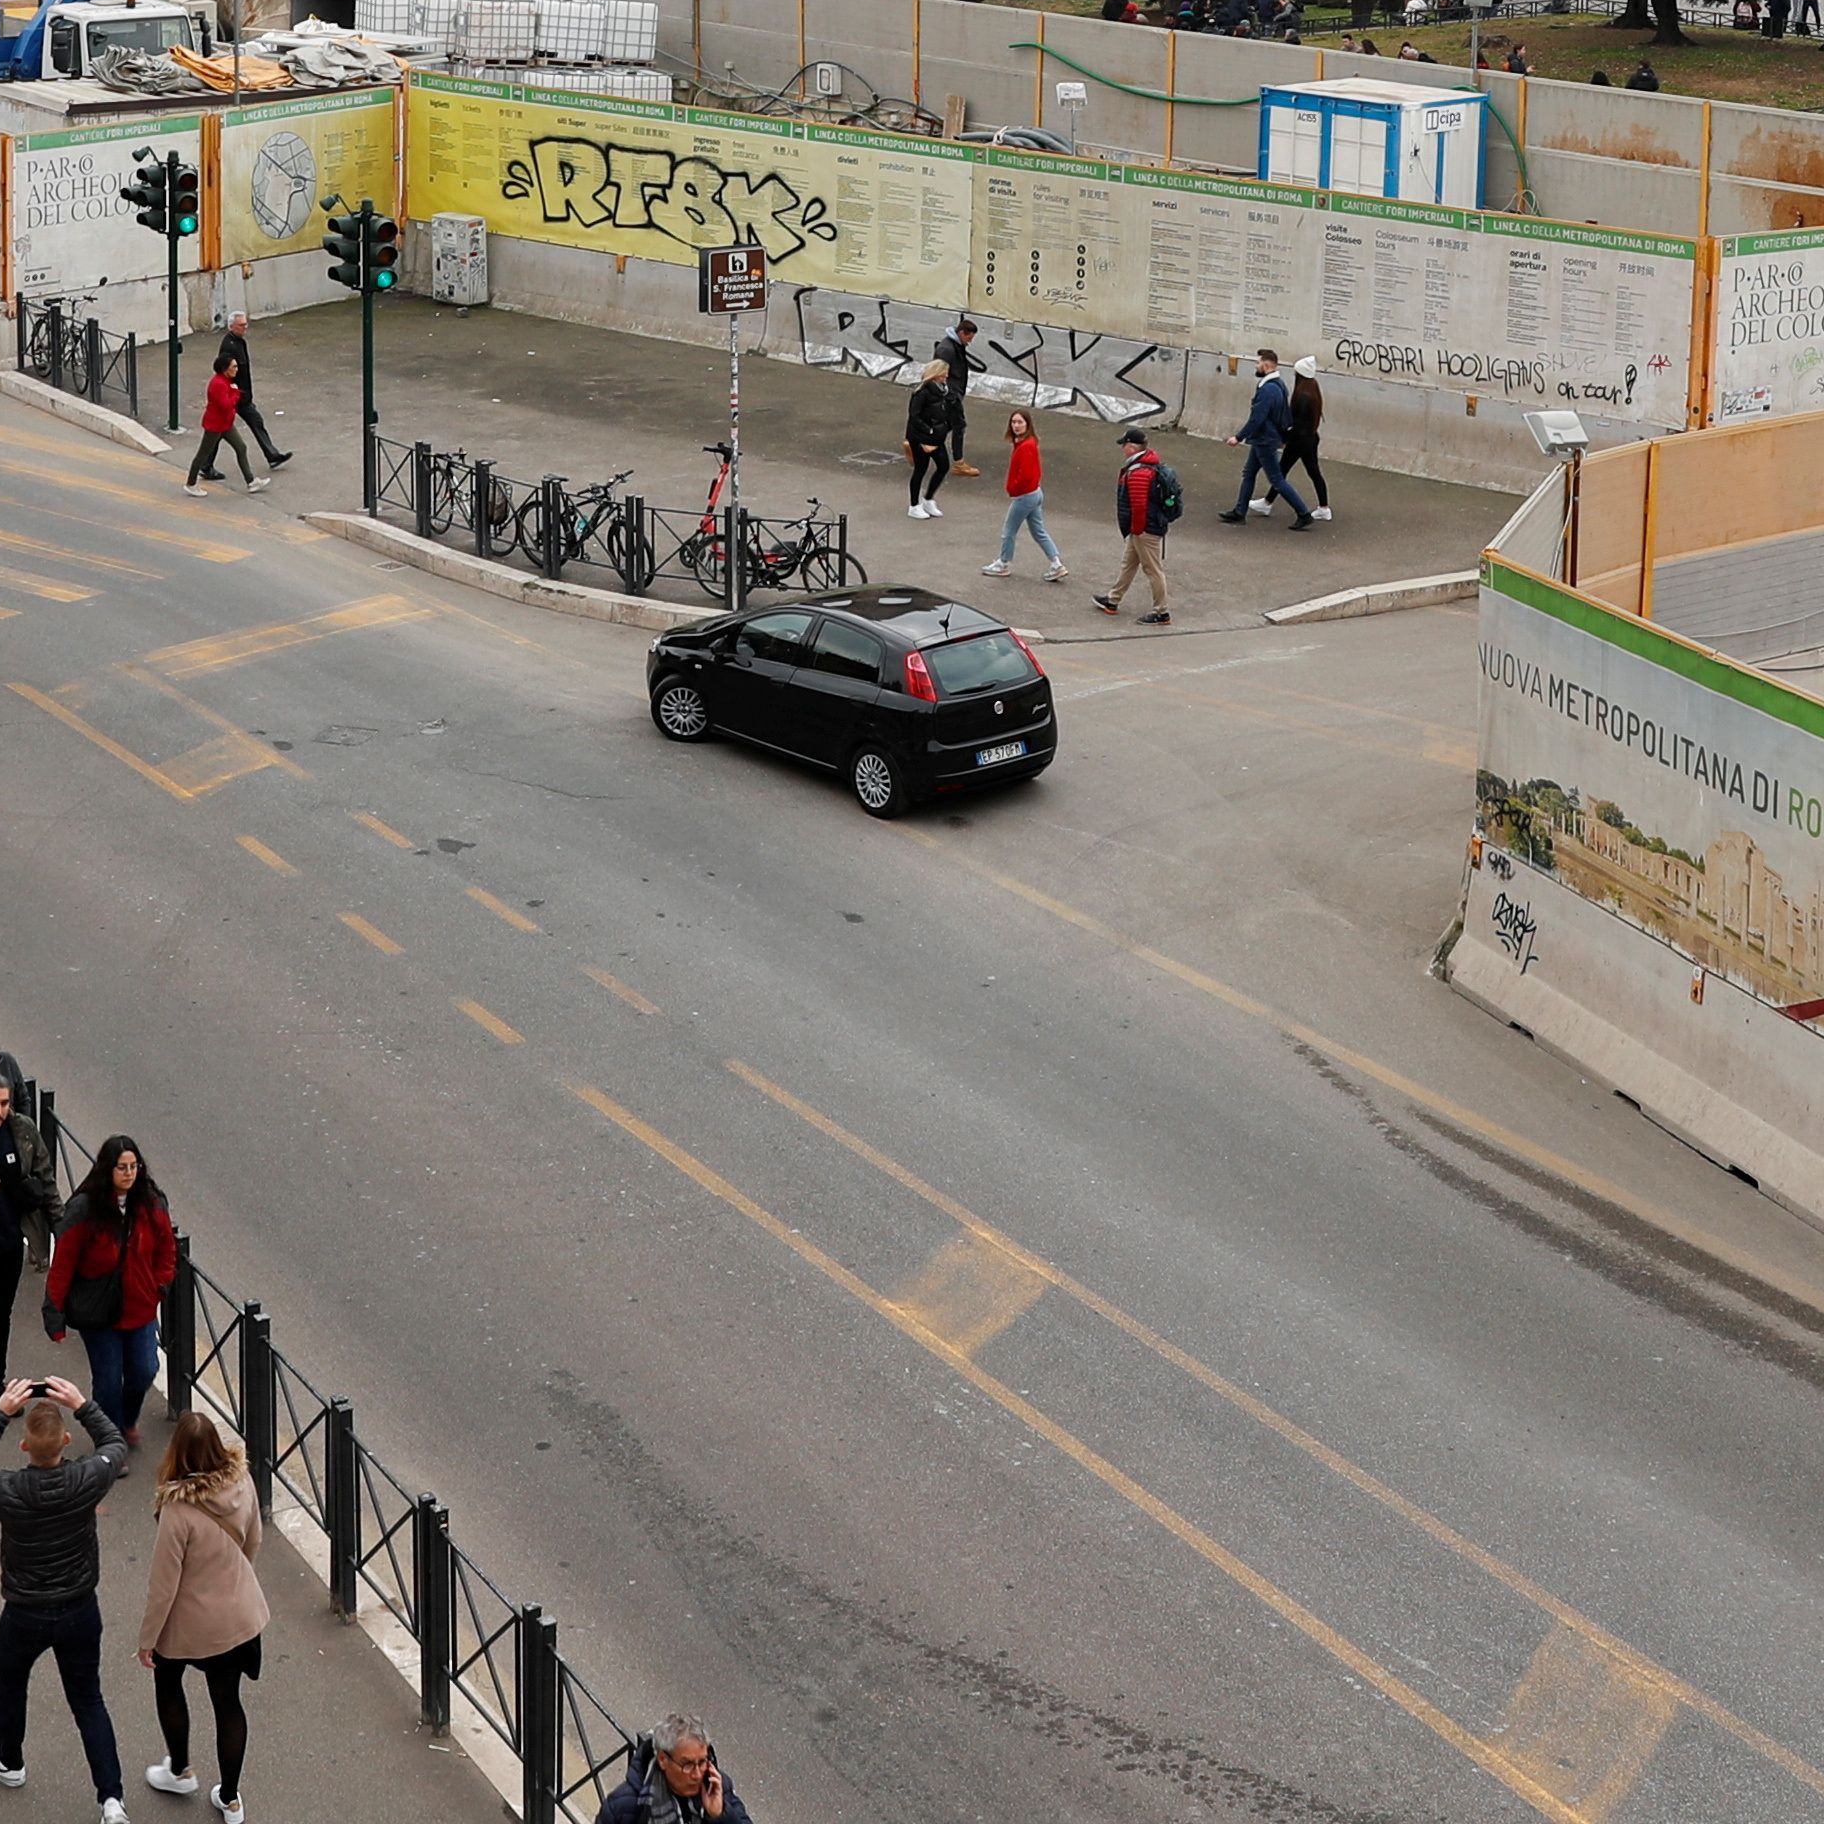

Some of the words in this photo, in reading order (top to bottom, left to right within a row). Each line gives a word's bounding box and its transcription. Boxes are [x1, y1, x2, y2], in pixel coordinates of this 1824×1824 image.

[695, 112, 727, 126] CANTIERE
[728, 117, 746, 129] FORI
[747, 120, 783, 134] IMPERIALI
[1439, 111, 1461, 125] cipa
[815, 128, 836, 140] LINEA
[838, 132, 844, 142] C
[845, 133, 867, 144] DELLA
[868, 136, 930, 154] METROPOLITANA
[931, 144, 939, 154] DI
[940, 146, 964, 158] ROMA
[837, 155, 858, 167] divieti
[878, 161, 915, 174] prohibition
[997, 154, 1035, 169] CANTIERE
[1036, 158, 1055, 171] FORI
[1056, 161, 1097, 177] IMPERIALI
[989, 177, 1013, 187] norme
[1033, 183, 1050, 193] rules
[1133, 172, 1156, 185] LINEA
[1158, 175, 1166, 186] C
[1167, 176, 1194, 189] DELLA
[1194, 180, 1265, 198] METROPOLITANA
[1266, 188, 1276, 200] DI
[1277, 190, 1303, 204] ROMA
[988, 186, 995, 195] di
[996, 186, 1017, 197] visita
[1032, 192, 1044, 201] for
[1045, 193, 1070, 207] visiting
[1152, 199, 1178, 210] servizi
[27, 205, 66, 229] DEL
[1199, 205, 1230, 218] services
[1341, 199, 1384, 215] CANTIERE
[1385, 204, 1407, 219] FORI
[1408, 207, 1454, 225] IMPERIALI
[1325, 223, 1348, 234] visite
[1325, 232, 1363, 246] Colosseo
[1376, 229, 1420, 245] Colosseum
[1493, 220, 1521, 233] LINEA
[1523, 223, 1531, 235] C
[1532, 225, 1561, 239] DELLA
[1562, 228, 1642, 248] METROPOLITANA
[1644, 238, 1656, 249] DI
[1657, 239, 1686, 255] ROMA
[1753, 237, 1791, 251] CANTIERE
[1792, 234, 1810, 248] FORI
[1376, 240, 1396, 252] tours
[1509, 249, 1529, 261] orari
[1530, 251, 1541, 262] di
[1509, 259, 1547, 273] apertura
[1563, 256, 1597, 270] opening
[1562, 265, 1587, 277] hours
[718, 275, 748, 284] Basilica
[713, 285, 721, 293] S.
[724, 282, 763, 292] Francesca
[723, 292, 754, 300] Romana
[1731, 318, 1772, 347] DEL
[1335, 339, 1424, 375] GROBARI
[1437, 350, 1546, 395] HOOLIGANS
[1478, 641, 1543, 703] NUOVA
[1549, 673, 1745, 804] METROPOLITANA
[1753, 769, 1778, 820] DI
